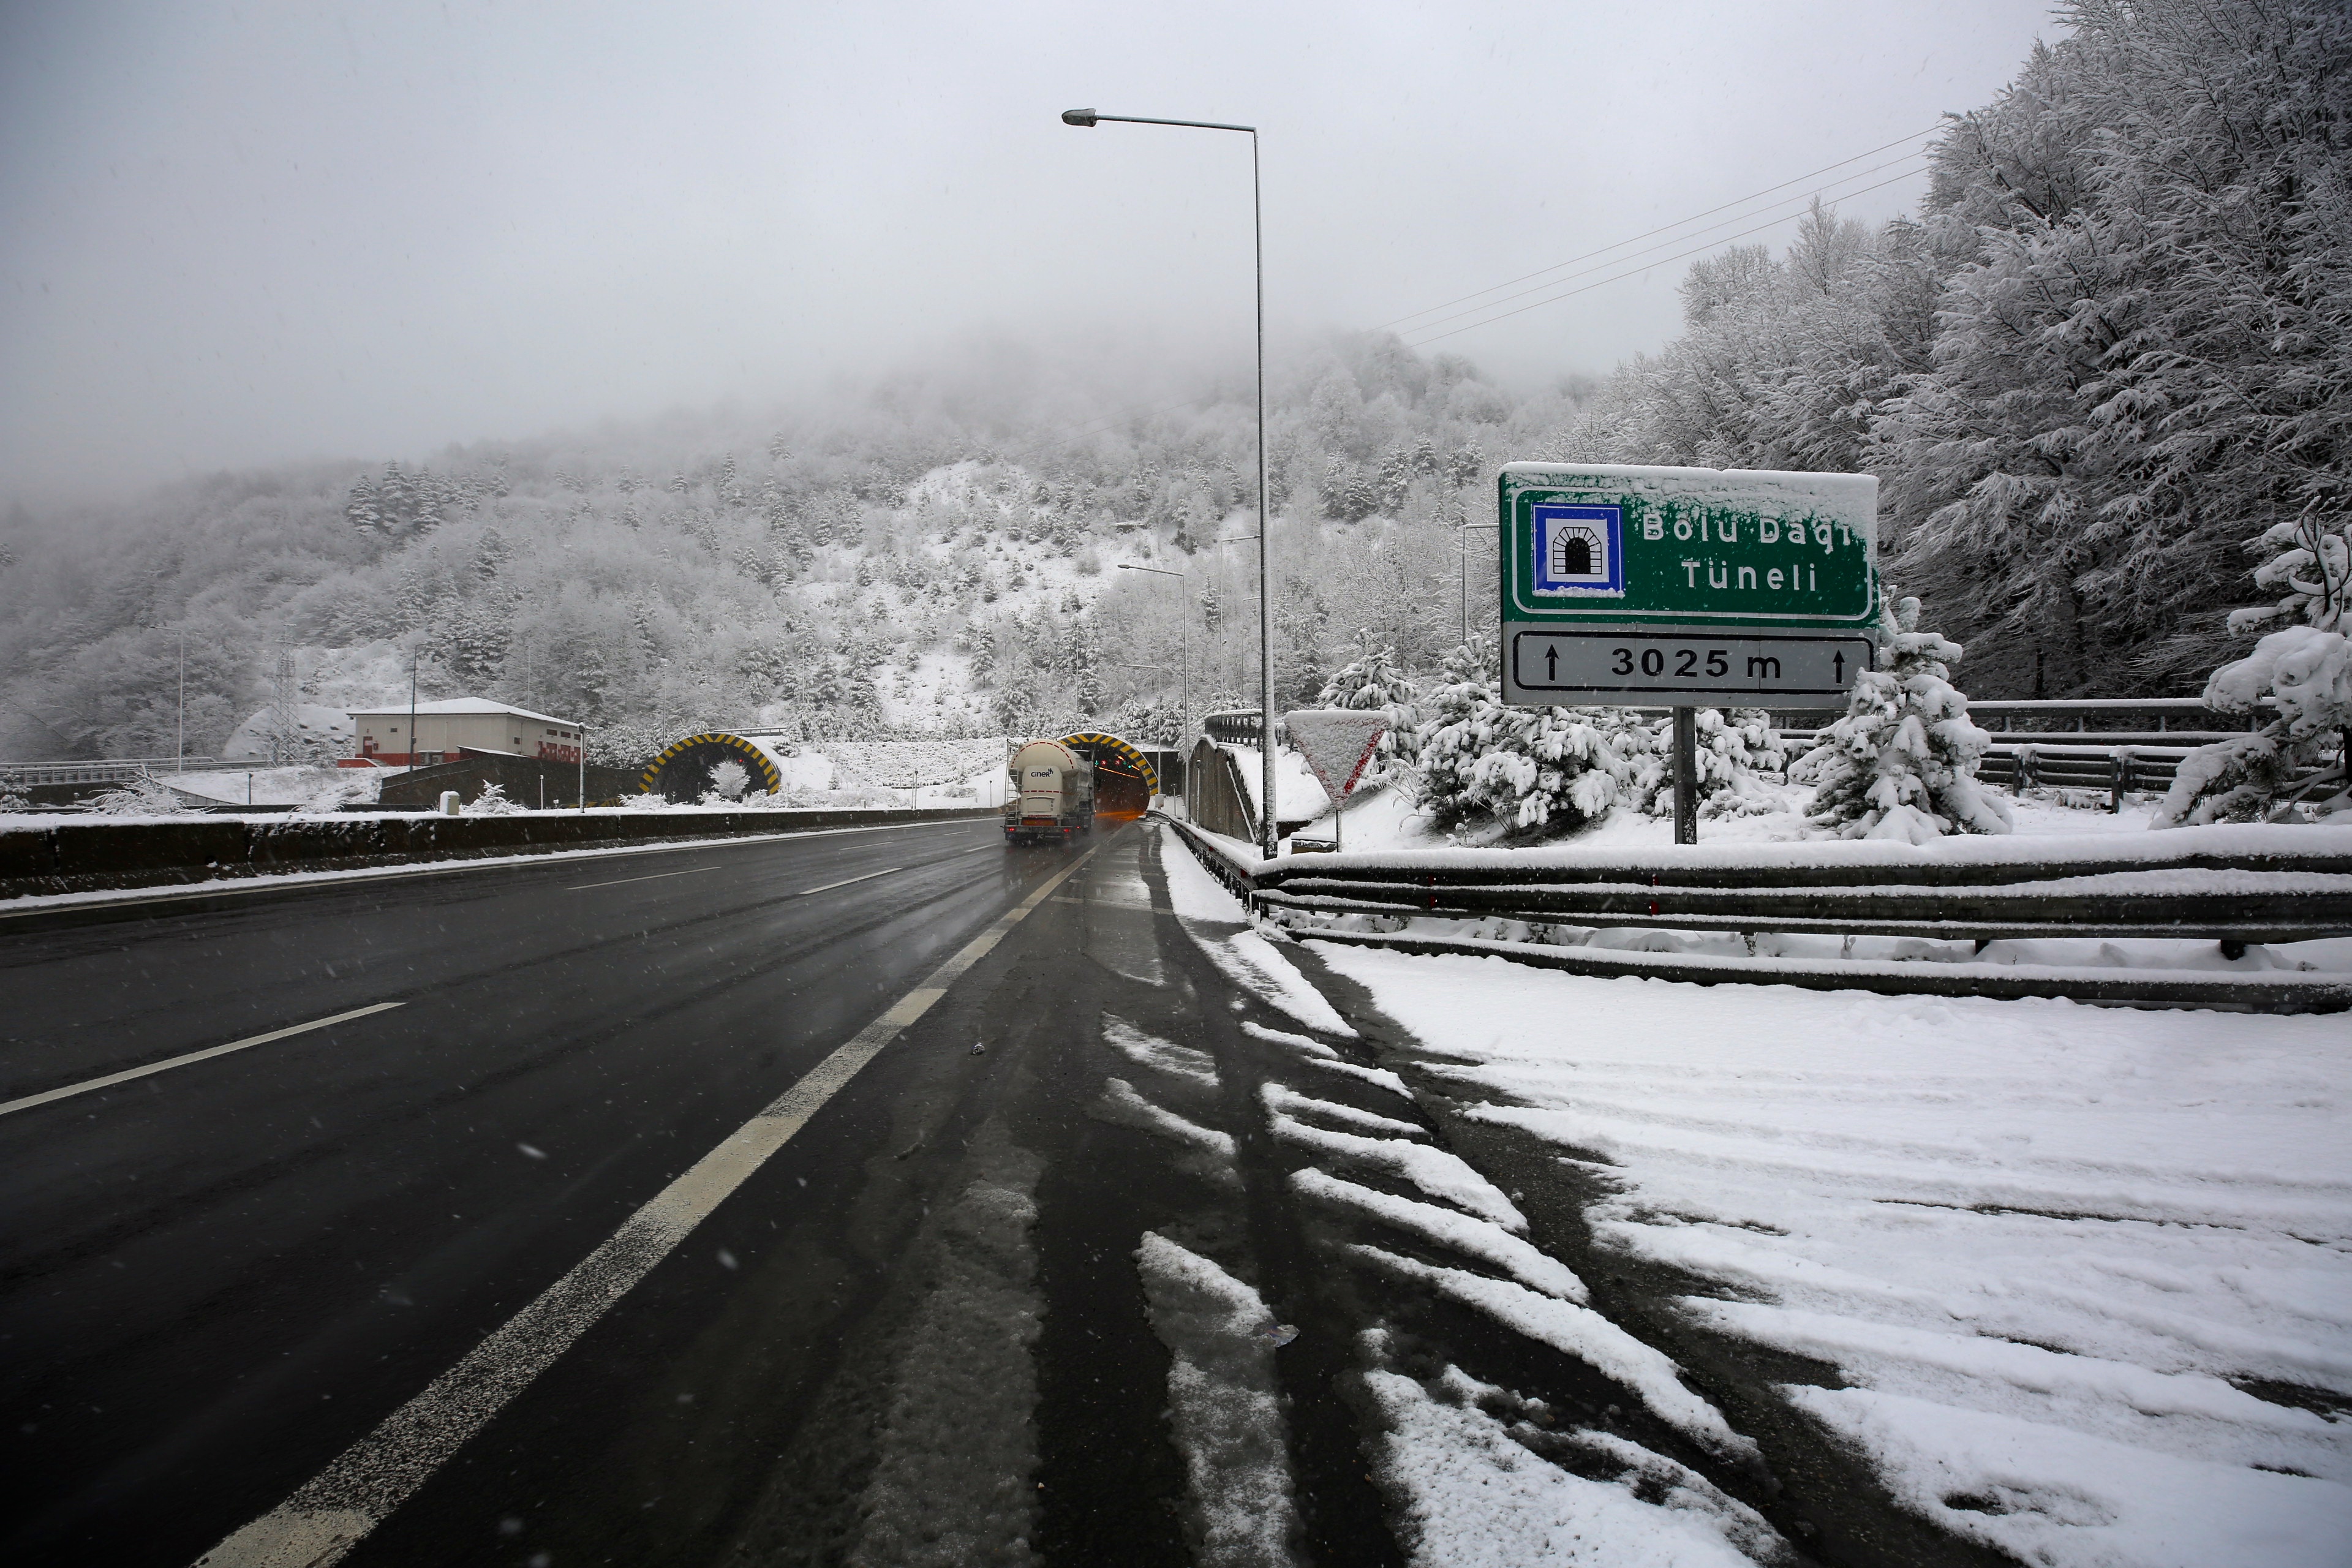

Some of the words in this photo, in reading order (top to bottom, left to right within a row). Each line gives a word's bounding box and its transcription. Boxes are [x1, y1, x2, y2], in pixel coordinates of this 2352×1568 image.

[1643, 513, 1738, 543] Bolu
[1681, 560, 1816, 592] Tüneli
[1611, 647, 1729, 677] 3025
[1747, 656, 1781, 679] m
